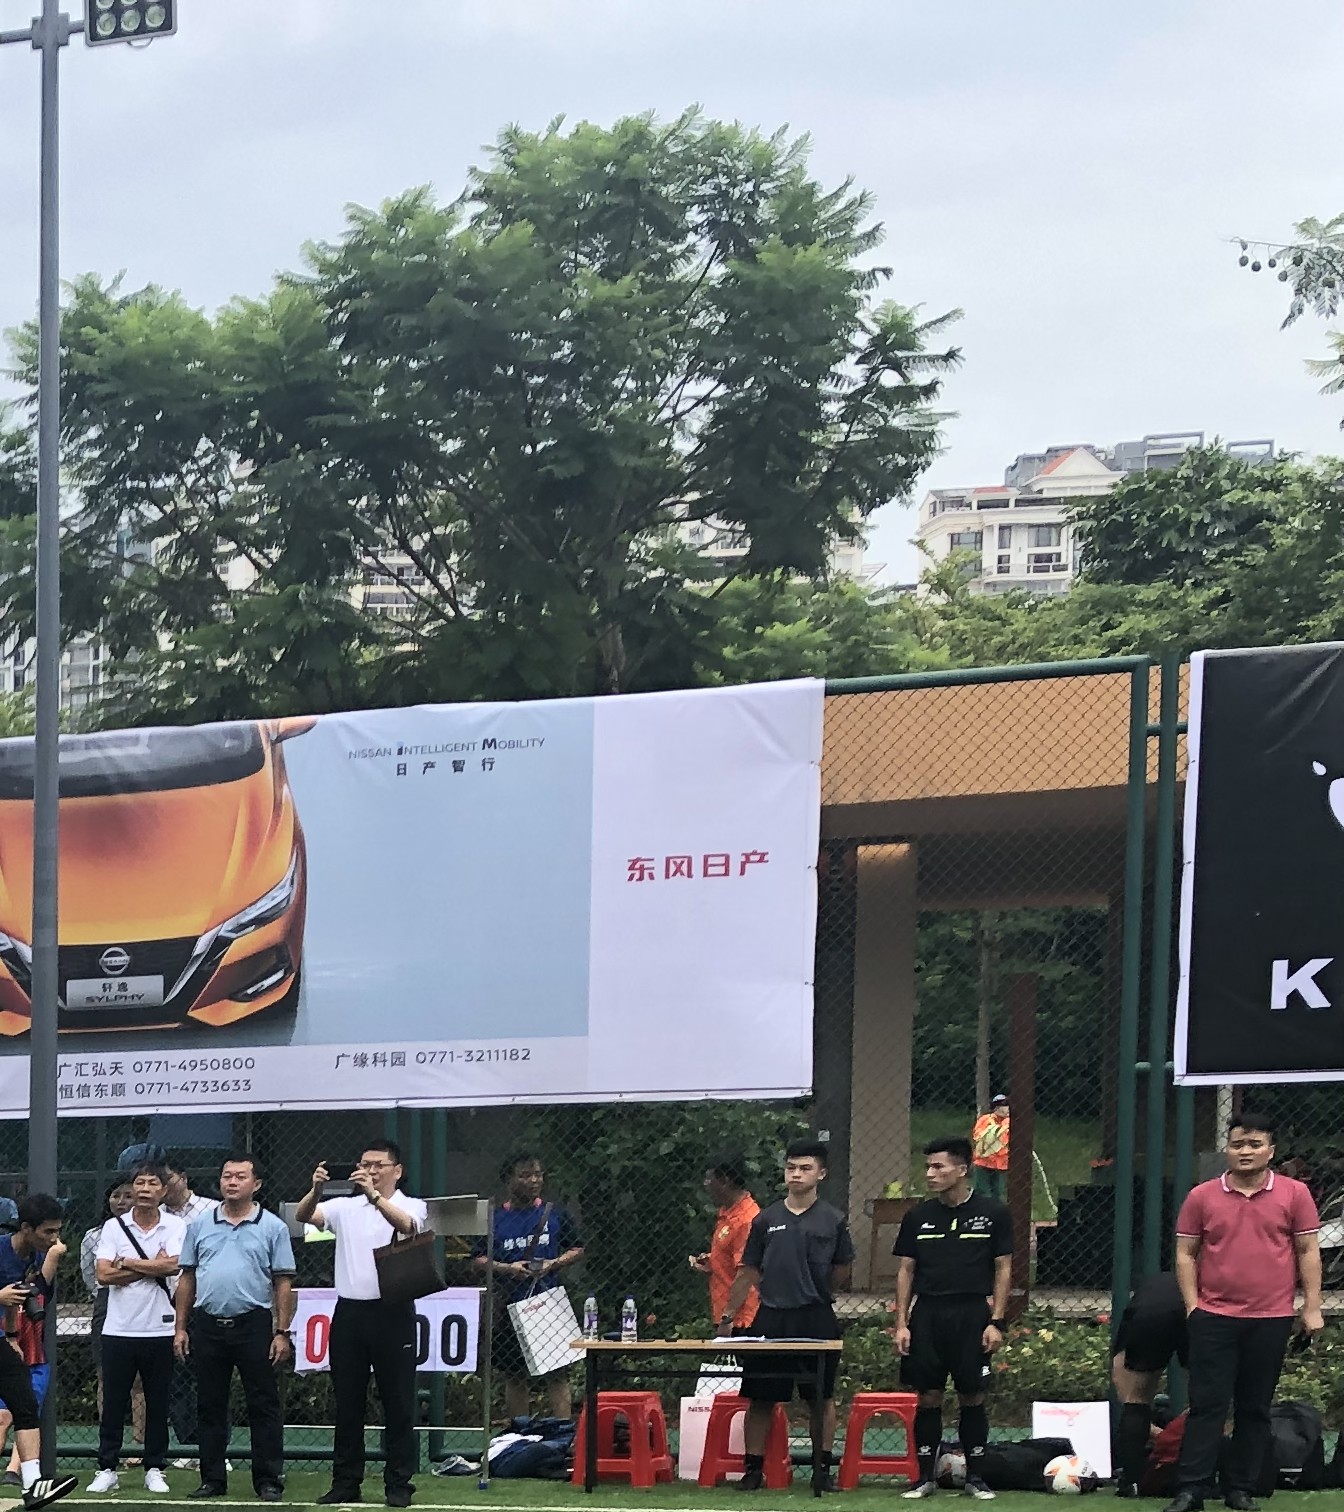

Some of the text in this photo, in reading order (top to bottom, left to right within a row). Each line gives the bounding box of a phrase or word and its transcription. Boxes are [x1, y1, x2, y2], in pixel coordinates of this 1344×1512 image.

[348, 747, 392, 759] NISSAN
[482, 737, 545, 750] MOBILITY
[396, 757, 495, 776] 日产智行
[627, 850, 771, 882] 东风日产
[1270, 957, 1334, 1010] K
[57, 1056, 256, 1079] 广汇弘天 0771-4950800
[334, 1047, 531, 1070] 广缘科园 0771-3211182
[58, 1079, 252, 1099] 恒信东顺 0771-4733633
